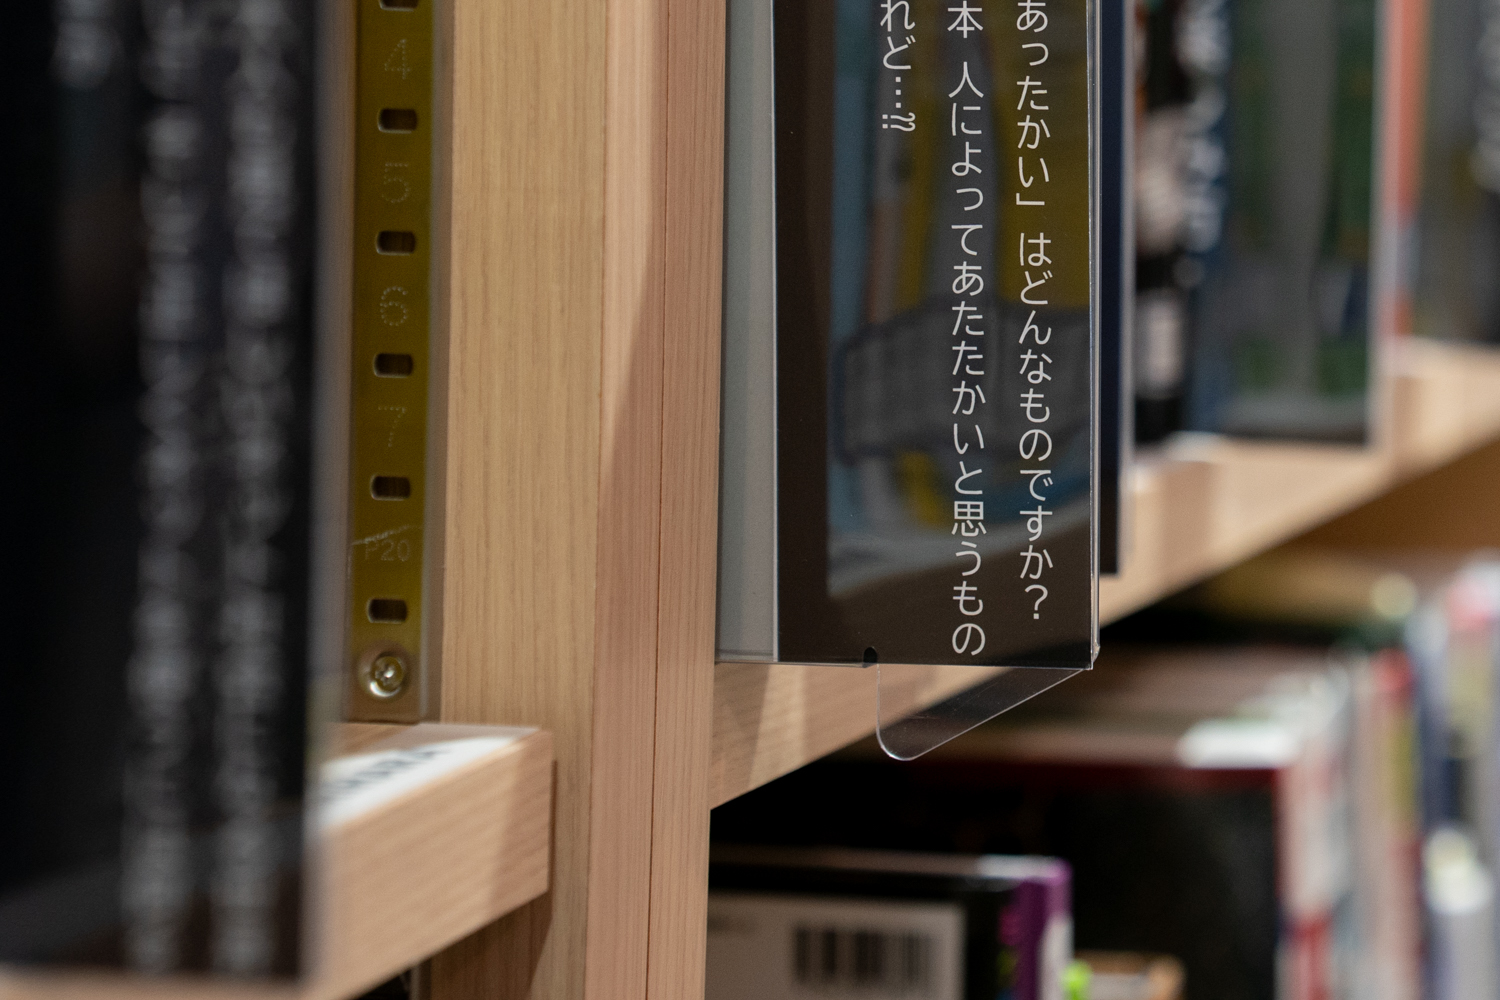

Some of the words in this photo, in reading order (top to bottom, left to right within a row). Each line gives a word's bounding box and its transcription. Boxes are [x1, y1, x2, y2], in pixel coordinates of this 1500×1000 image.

[383, 38, 412, 80] 4
[383, 162, 411, 204] 5
[379, 285, 408, 327] 6
[378, 405, 408, 448] 7
